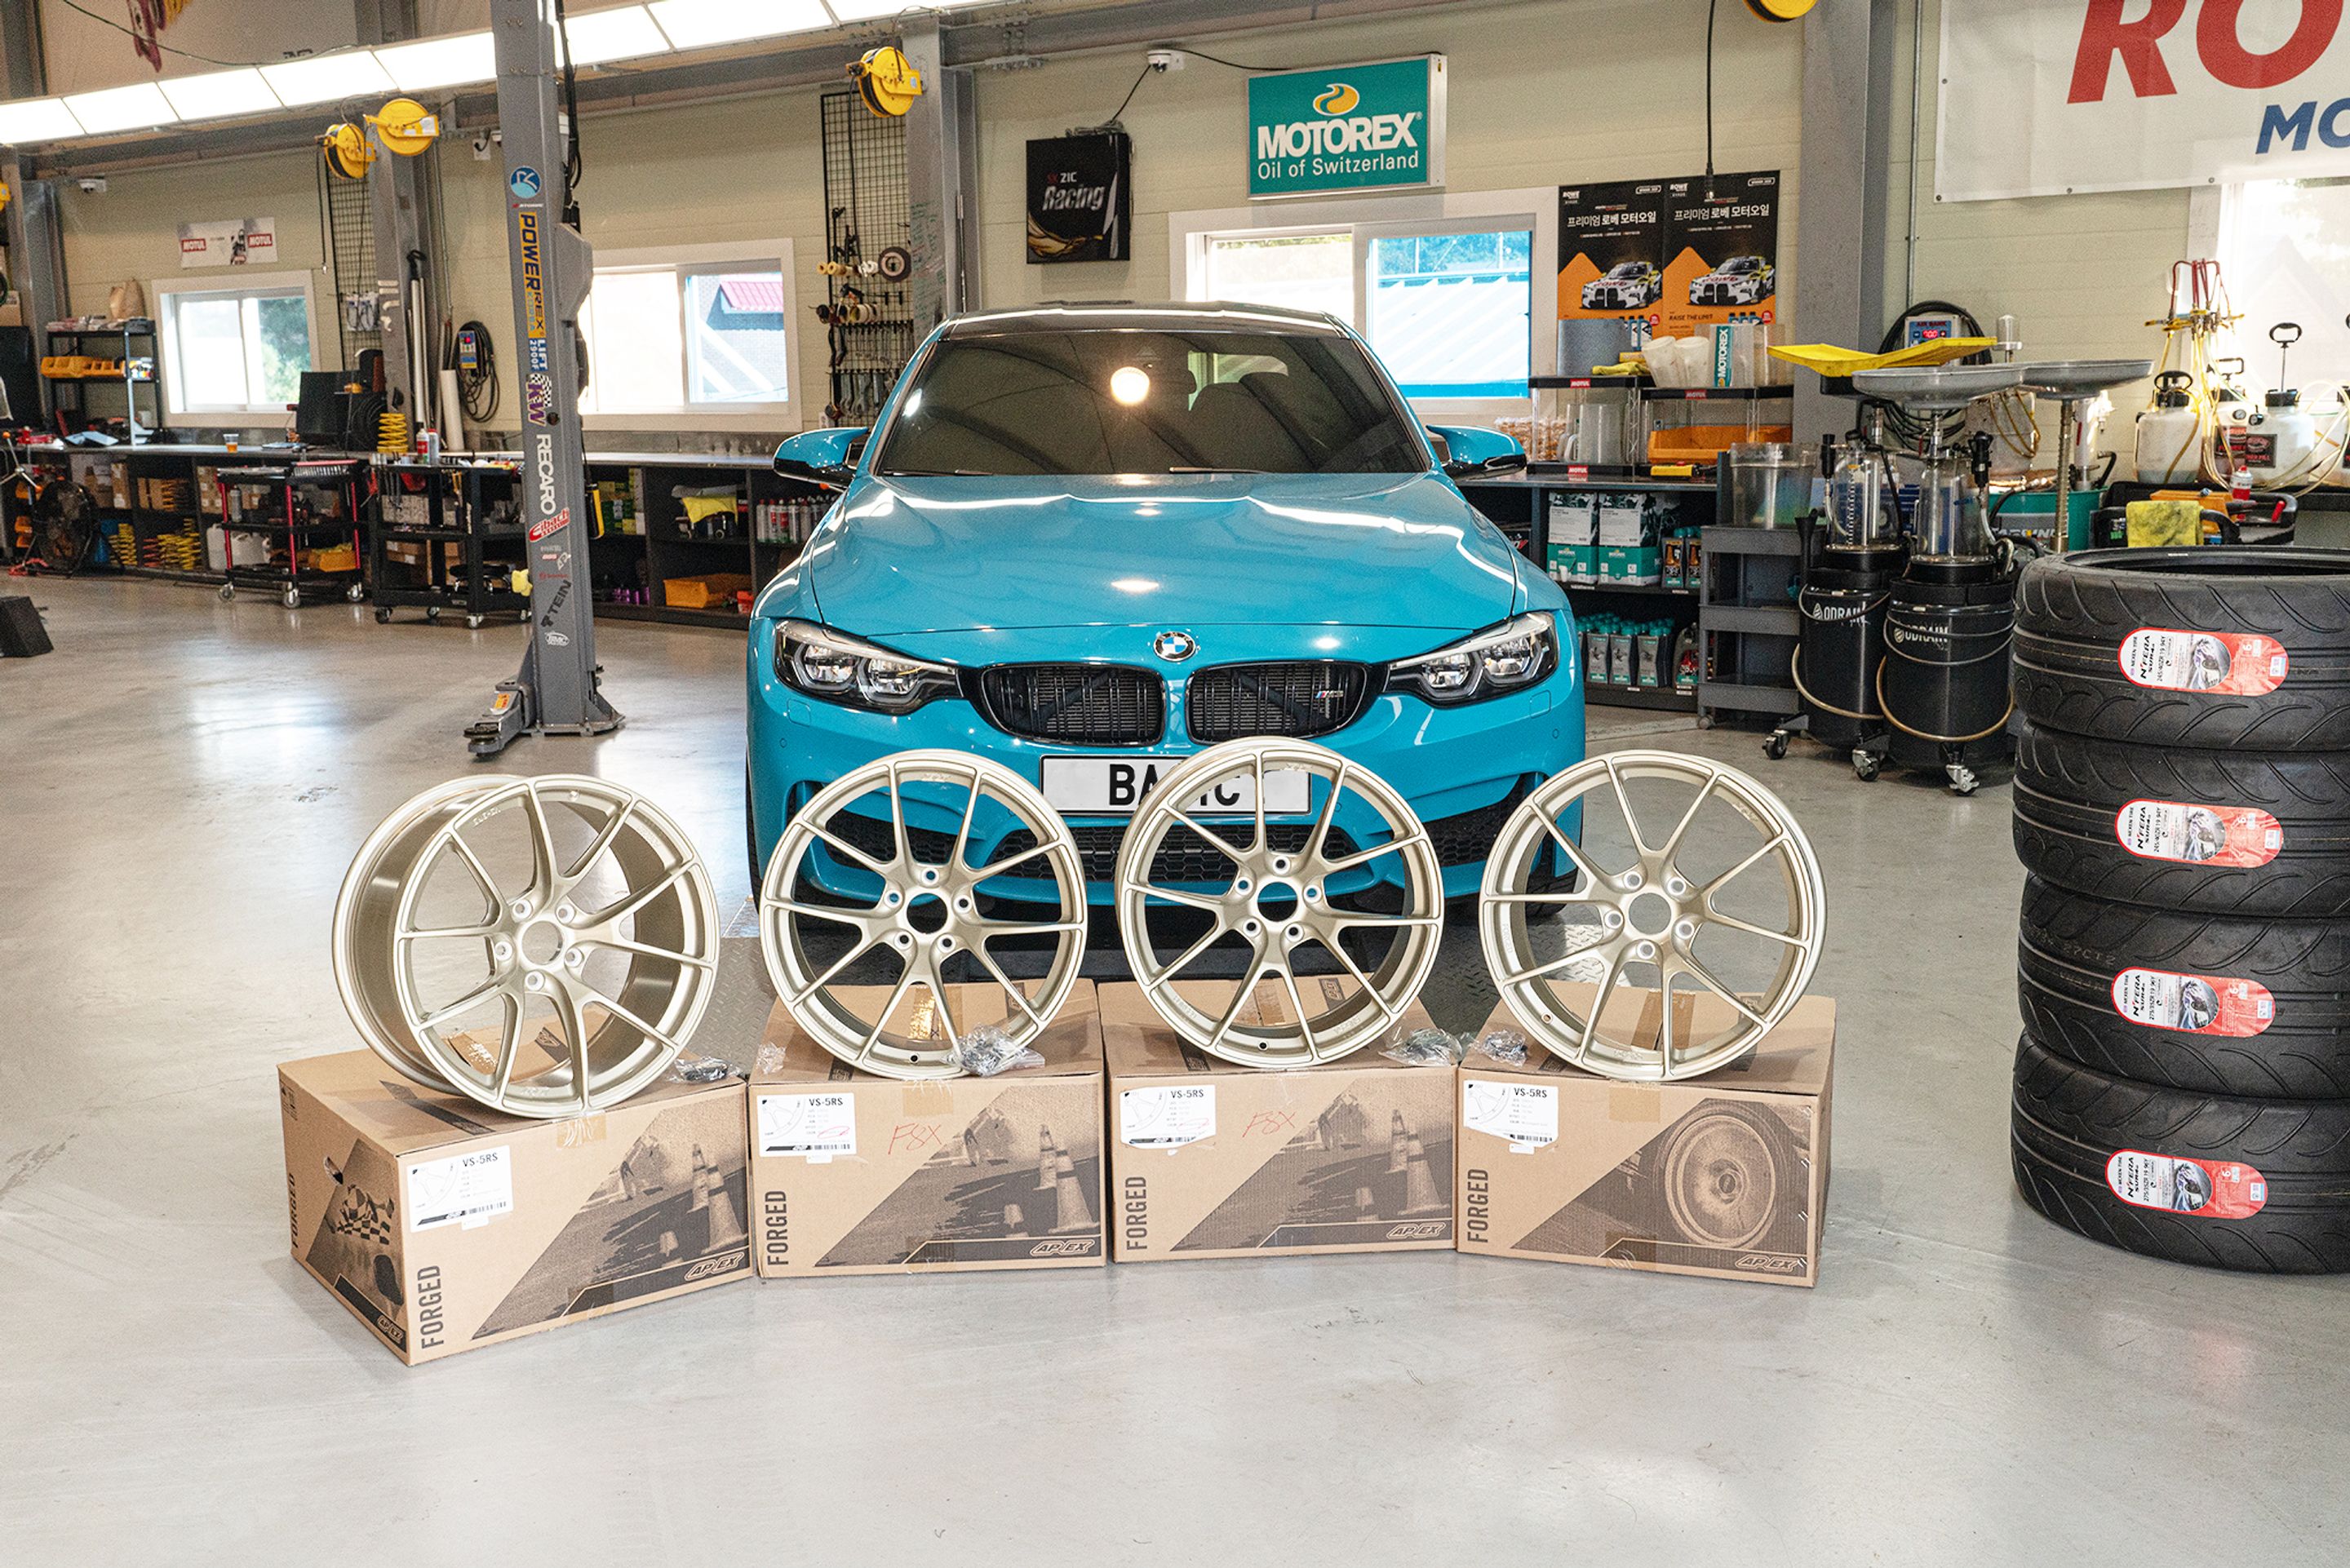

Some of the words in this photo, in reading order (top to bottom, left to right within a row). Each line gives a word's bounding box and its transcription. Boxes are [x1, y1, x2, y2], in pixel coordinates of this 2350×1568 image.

[1257, 113, 1419, 160] MOTOREX
[1060, 171, 1077, 183] ZIC
[1257, 161, 1282, 179] Oil
[1288, 158, 1306, 176] of
[1312, 150, 1419, 174] Switzerland
[1042, 184, 1105, 210] Racing
[1674, 208, 1709, 221] 프리미엄
[1710, 206, 1730, 219] 로베
[1731, 203, 1770, 217] 모터오일
[1567, 215, 1600, 228] 프리미엄
[1602, 213, 1619, 225] 로베
[1621, 210, 1656, 224] 모터오일
[537, 339, 548, 370] LIFT
[1718, 329, 1728, 378] MOTOREX
[526, 382, 547, 427] KW
[536, 434, 556, 515] RECARO
[548, 579, 571, 614] TEIN
[1110, 764, 1240, 806] BAC
[809, 1097, 844, 1106] VS-5RS
[1170, 1089, 1204, 1099] VS-5RS
[1514, 1087, 1548, 1098] VS-5RS
[462, 1152, 498, 1167] VS-5RS
[290, 1173, 299, 1249] FORGED
[1126, 1176, 1147, 1251] FORGED
[1467, 1169, 1488, 1243] FORGED
[767, 1190, 789, 1266] FORGED
[421, 1265, 445, 1349] FORGED
